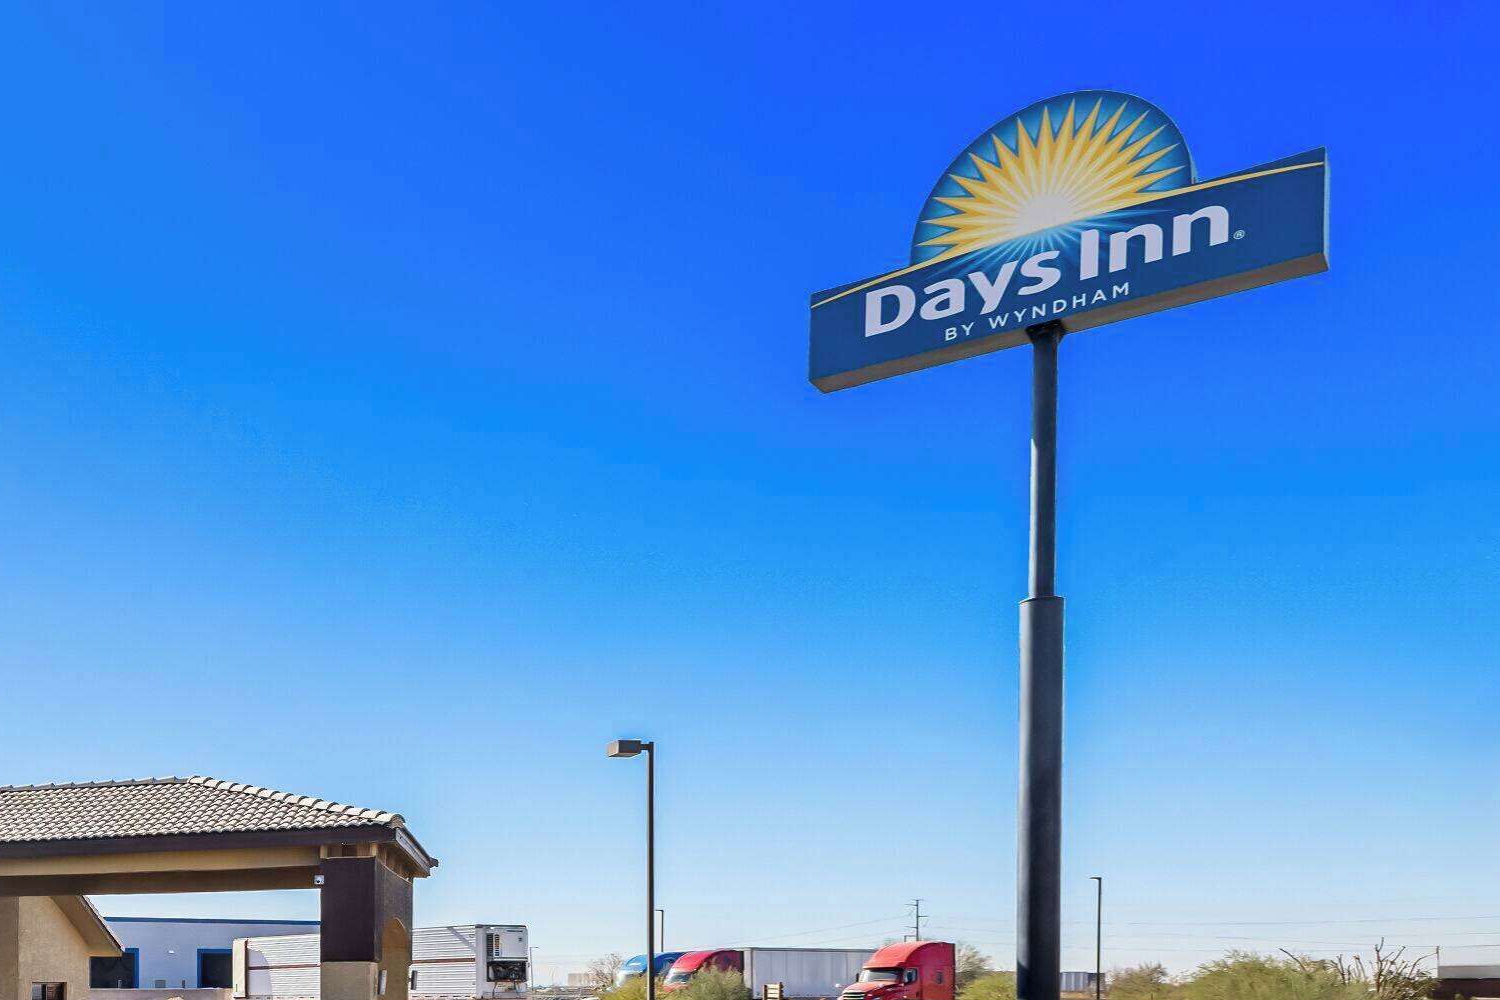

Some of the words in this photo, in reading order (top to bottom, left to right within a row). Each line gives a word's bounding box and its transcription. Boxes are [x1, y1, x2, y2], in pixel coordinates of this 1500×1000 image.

[864, 250, 1061, 338] Days
[945, 322, 974, 341] BY
[988, 282, 1131, 330] WYNDHAM
